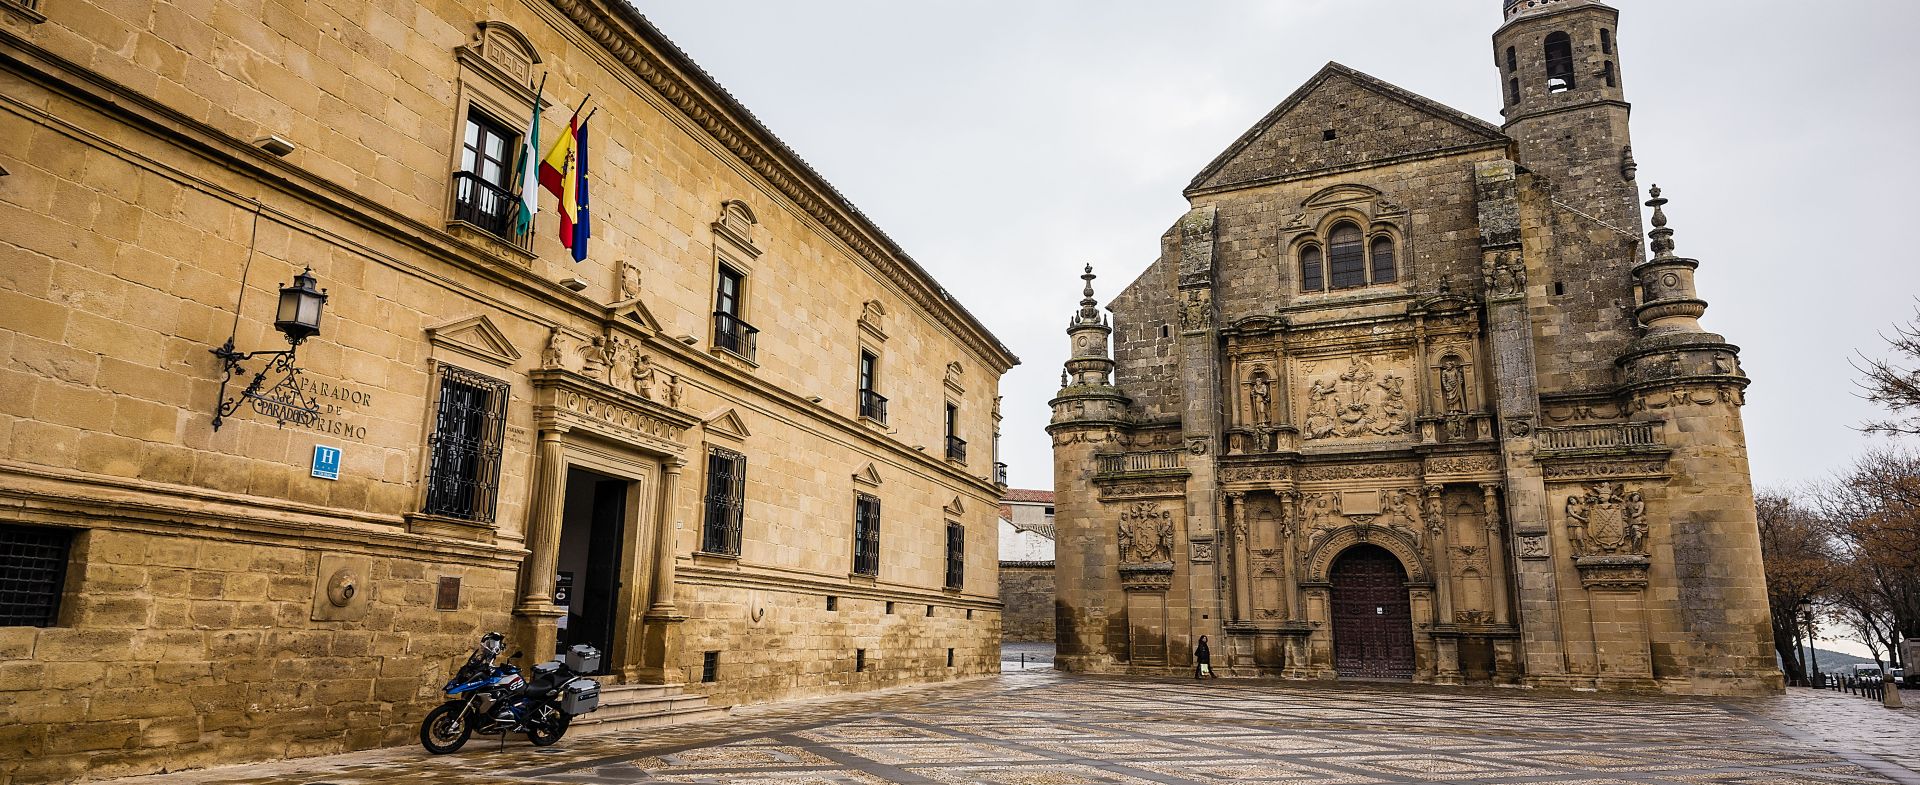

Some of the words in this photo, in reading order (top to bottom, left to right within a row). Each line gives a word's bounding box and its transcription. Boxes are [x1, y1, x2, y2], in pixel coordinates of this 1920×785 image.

[300, 377, 371, 407] PARADOR
[327, 404, 342, 416] DE
[321, 448, 335, 464] H
[509, 679, 524, 691] GS
